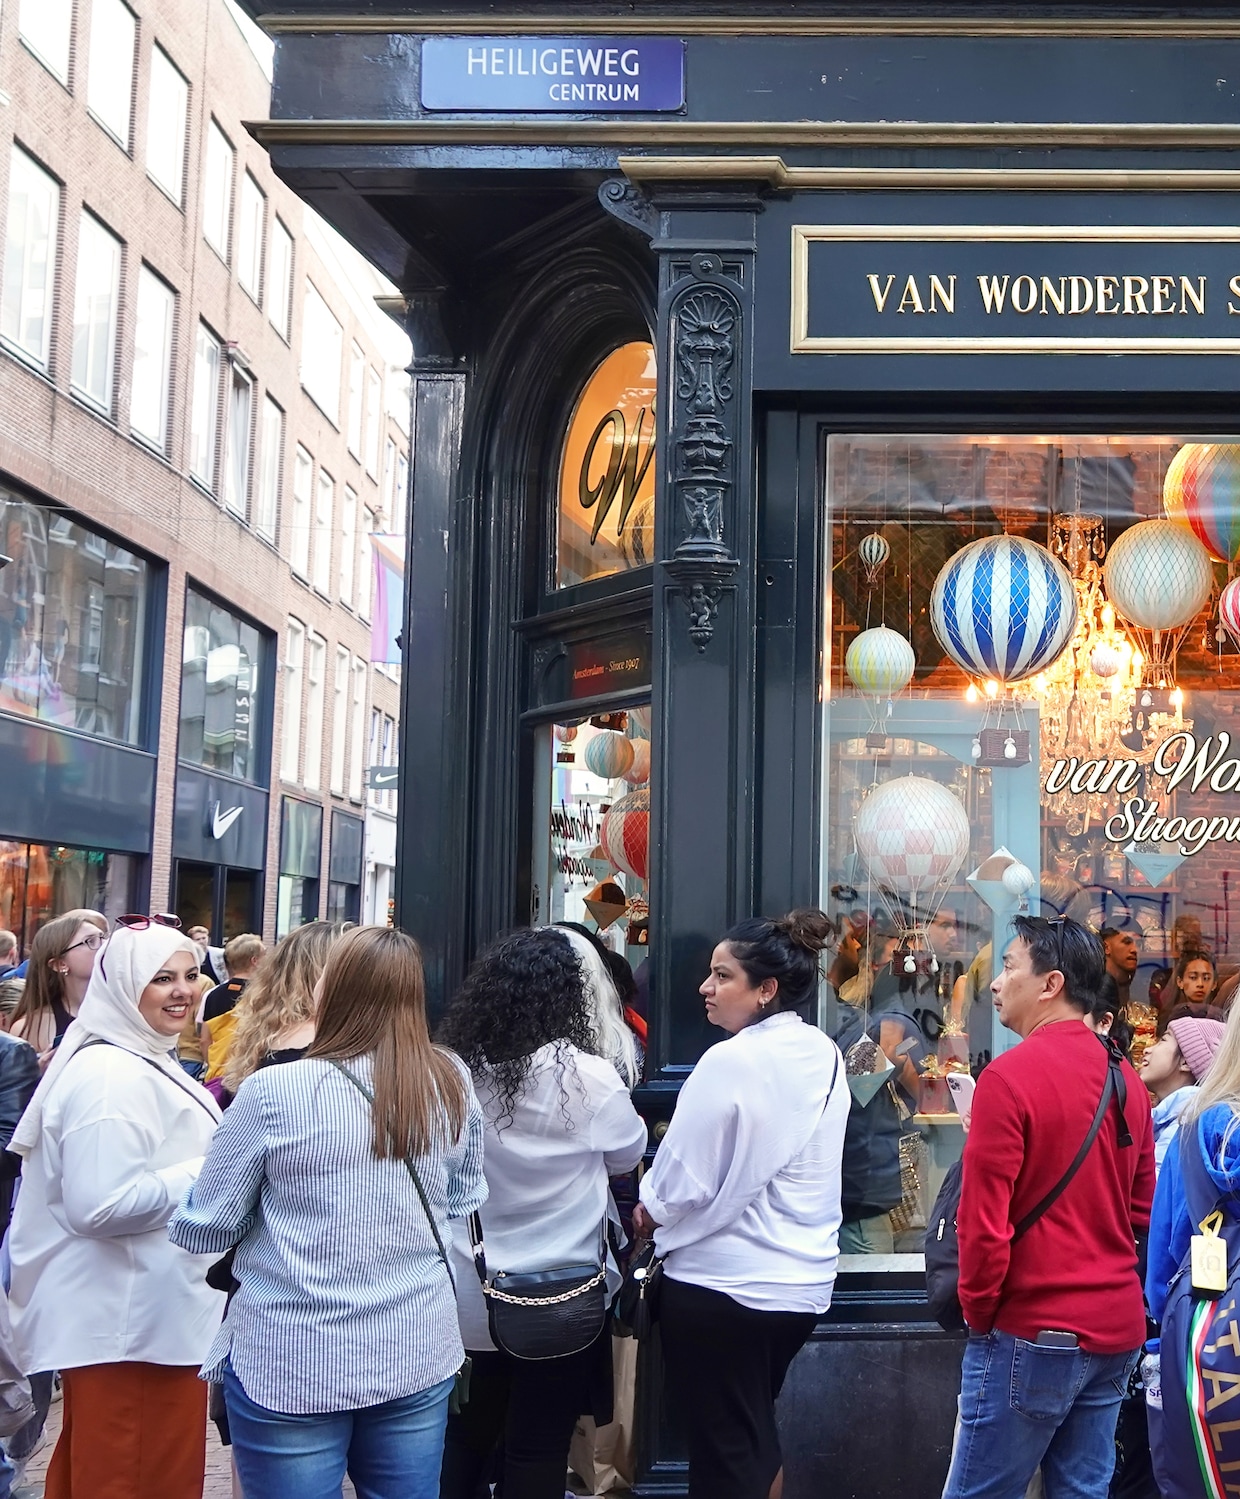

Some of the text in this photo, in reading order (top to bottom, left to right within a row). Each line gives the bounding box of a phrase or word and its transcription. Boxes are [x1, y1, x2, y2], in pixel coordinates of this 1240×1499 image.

[467, 48, 640, 76] HEILIGEWEG
[549, 83, 639, 101] CENTRUM
[866, 274, 957, 314] VAN
[976, 274, 1208, 315] WONDEREN
[579, 395, 657, 546] W
[574, 664, 604, 679] Amsterdam
[608, 660, 625, 672] Since
[625, 657, 640, 671] 1907
[1045, 755, 1142, 795] van
